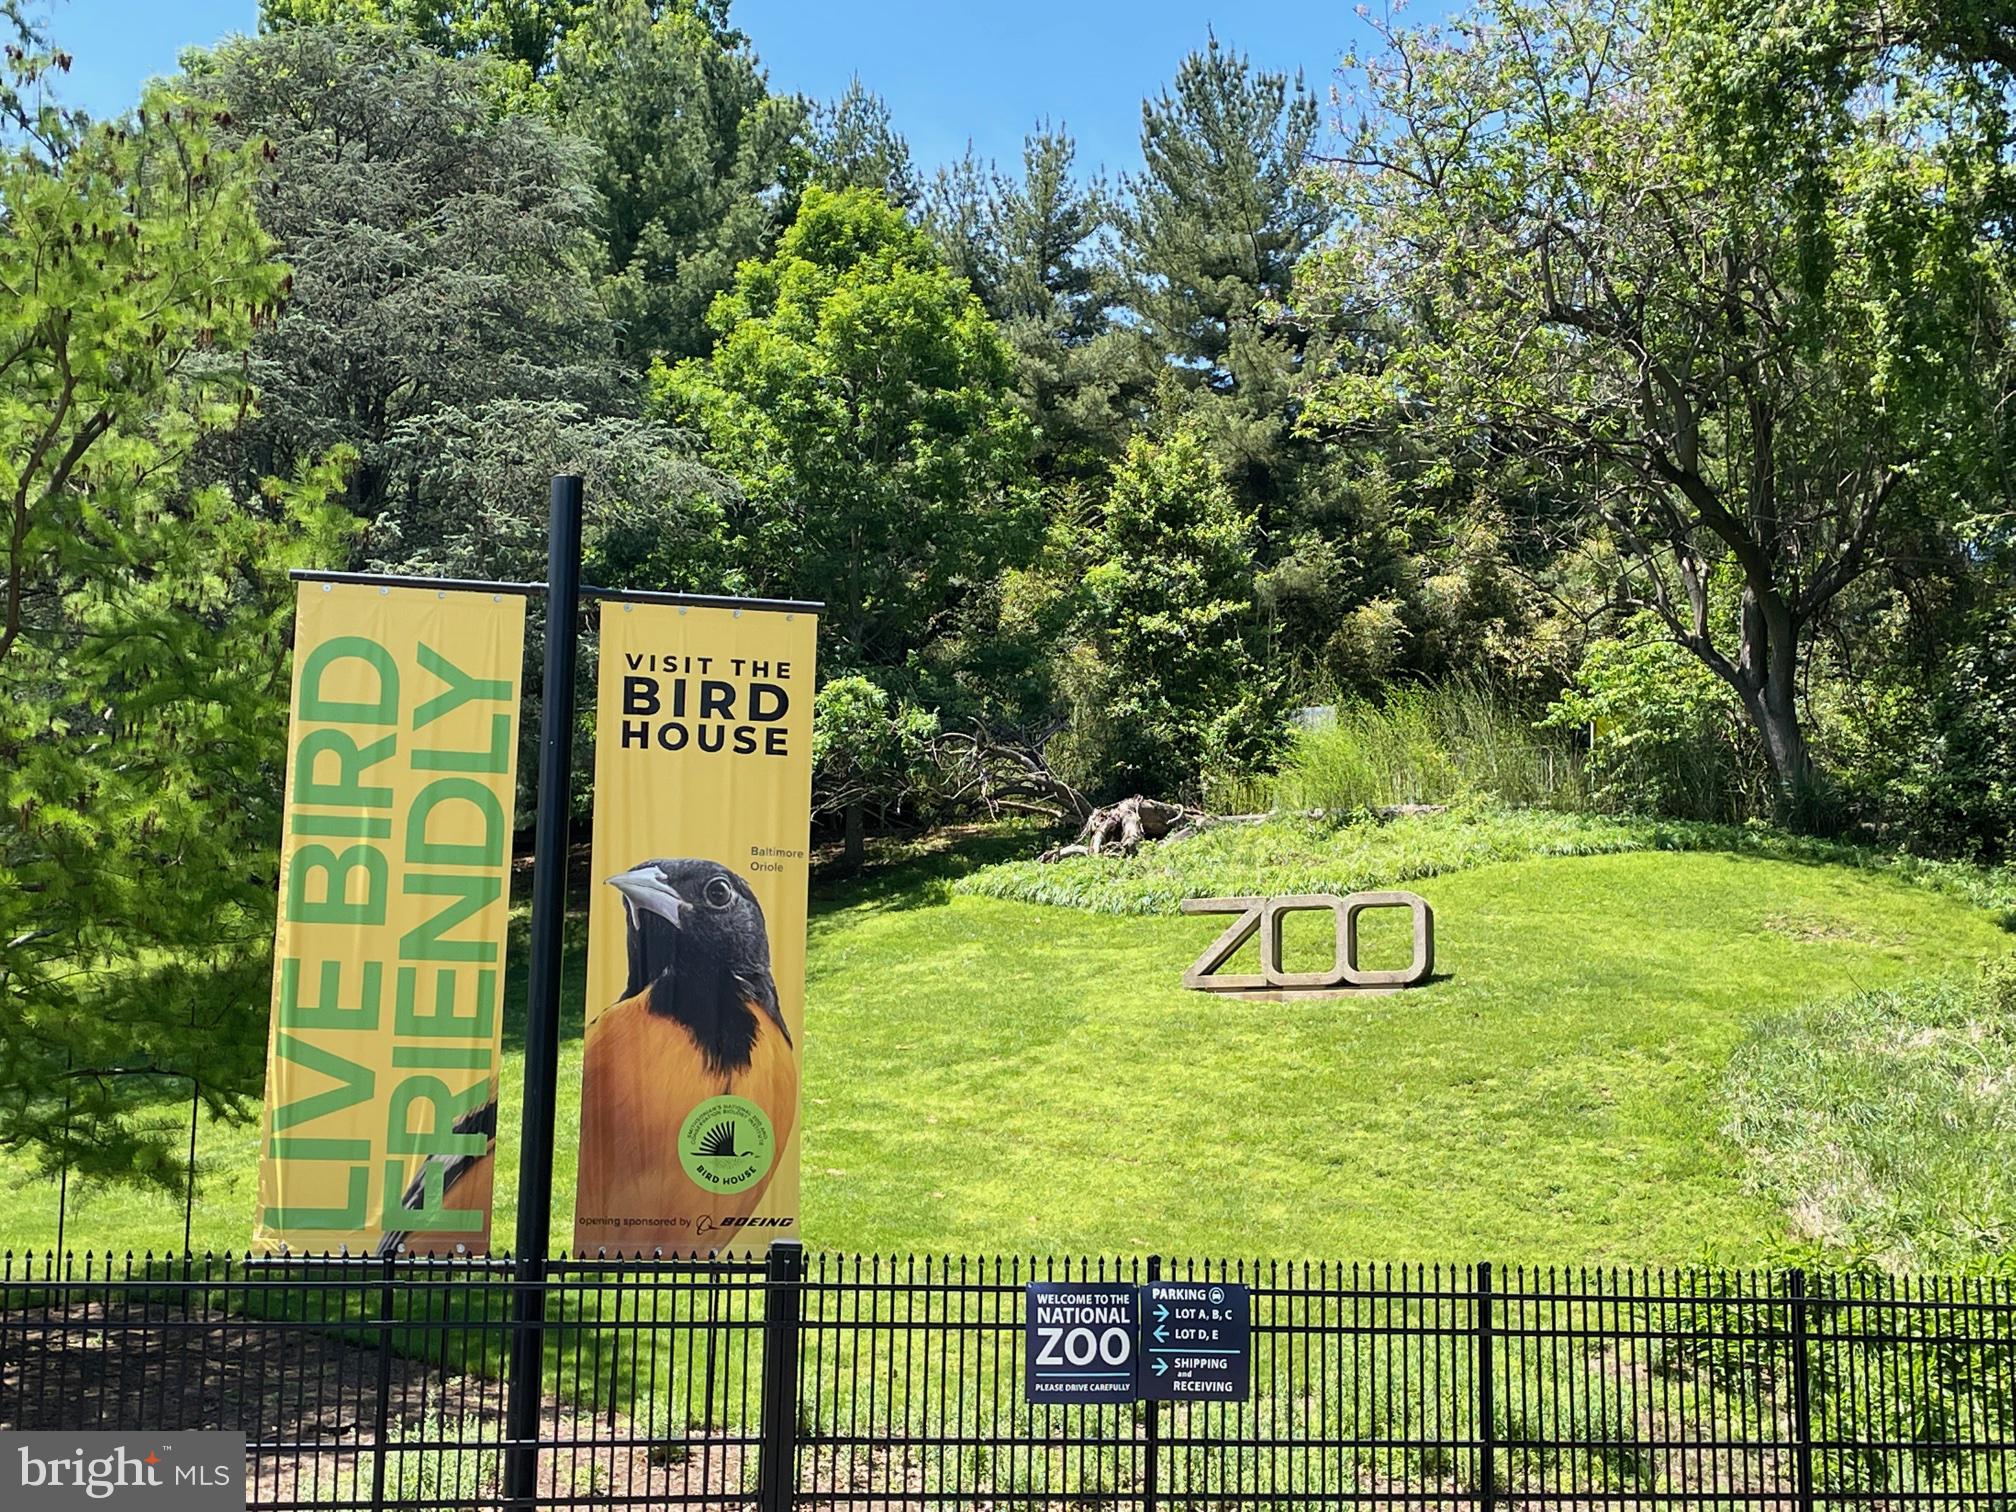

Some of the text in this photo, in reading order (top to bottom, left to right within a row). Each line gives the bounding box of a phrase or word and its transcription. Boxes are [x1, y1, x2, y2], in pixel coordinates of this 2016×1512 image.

[625, 653, 791, 679] VISIT THE
[622, 675, 790, 722] BIRD
[621, 720, 789, 757] HOUSE
[751, 846, 804, 859] Baltimore
[750, 861, 784, 873] Oriole
[263, 635, 401, 1231] LIVE BIRD
[380, 640, 513, 1232] FRIENDLY
[1181, 891, 1435, 989] ZOO
[723, 1104, 752, 1117] NATIONAL
[696, 1165, 757, 1185] BIRD HOUSE
[579, 1217, 794, 1228] opening sponsored by BOEING
[1037, 1294, 1130, 1304] WELCOME TO THE
[1152, 1288, 1206, 1300] PARKING
[1037, 1307, 1130, 1324] NATIONAL
[1175, 1309, 1233, 1321] LOT A, B, C
[1175, 1329, 1219, 1341] LOT D, E
[1035, 1327, 1130, 1366] ZOO
[1174, 1358, 1228, 1369] SHIPPING
[1177, 1370, 1192, 1378] and
[1090, 1383, 1130, 1391] CAREFULLY
[1173, 1381, 1233, 1392] RECEIVING
